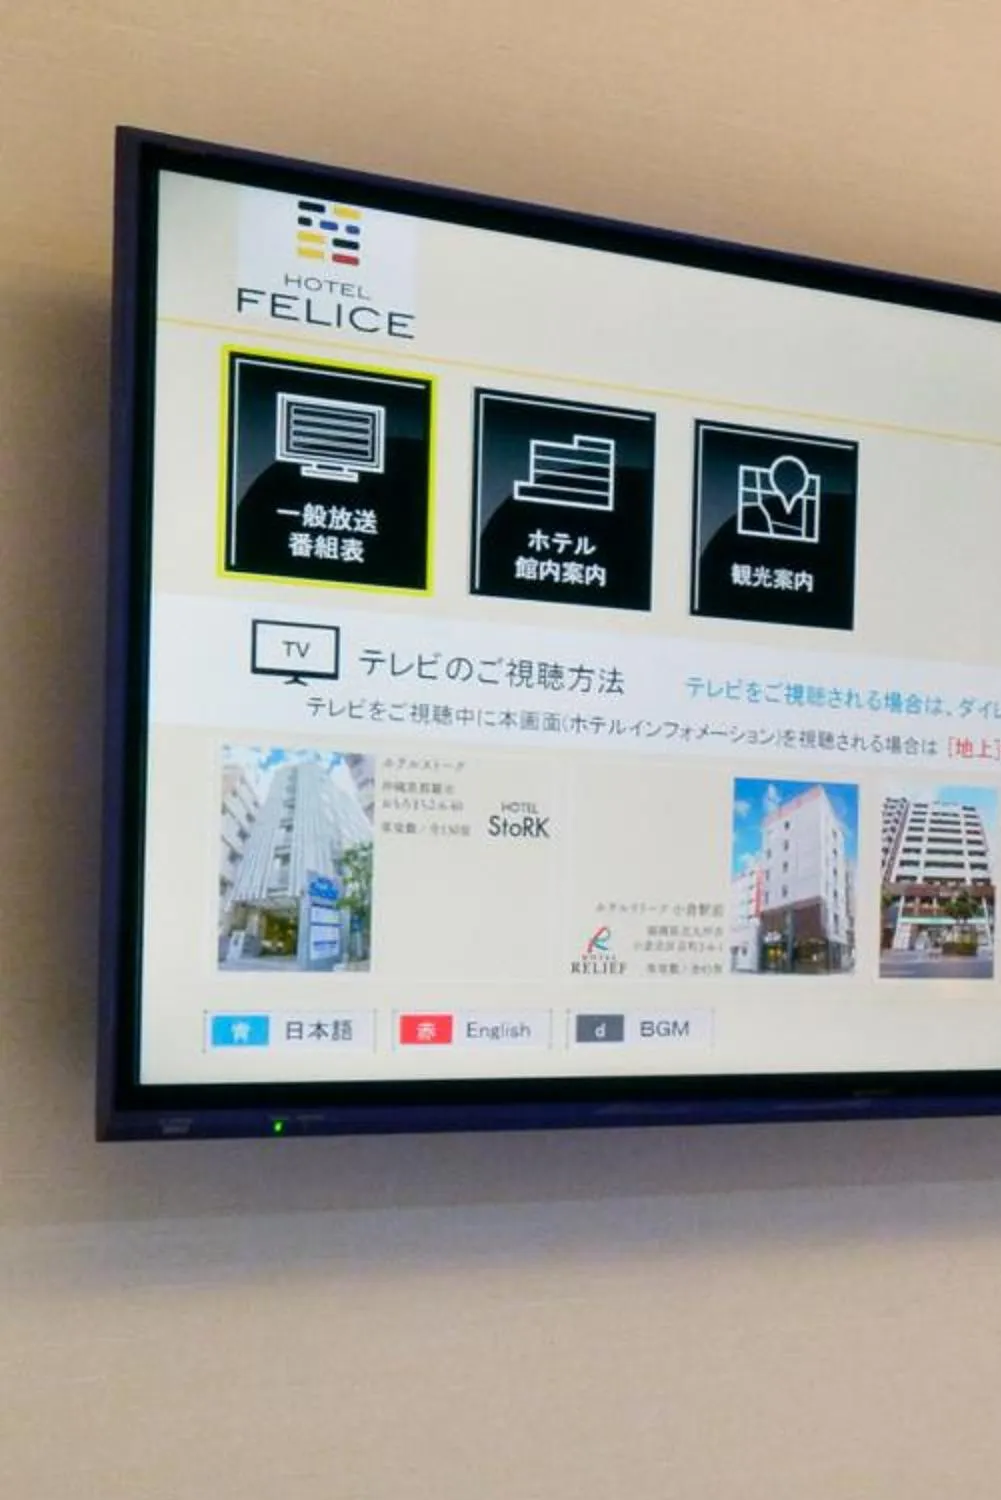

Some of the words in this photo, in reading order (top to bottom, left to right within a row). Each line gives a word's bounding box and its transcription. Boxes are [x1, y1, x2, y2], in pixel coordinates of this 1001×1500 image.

[284, 273, 371, 300] HOTEL
[236, 289, 415, 339] FELICE
[276, 503, 379, 535] 一般放送
[287, 533, 366, 564] 番組表
[527, 529, 596, 556] ホテル
[514, 555, 607, 587] 館内案内
[731, 563, 814, 592] 観光案内
[282, 641, 311, 659] TV
[358, 648, 626, 696] テレビのご視聴方法
[488, 815, 550, 838] StoRK
[286, 1019, 354, 1044] 日本語
[466, 1022, 532, 1044] English
[640, 1021, 691, 1038] BGM
